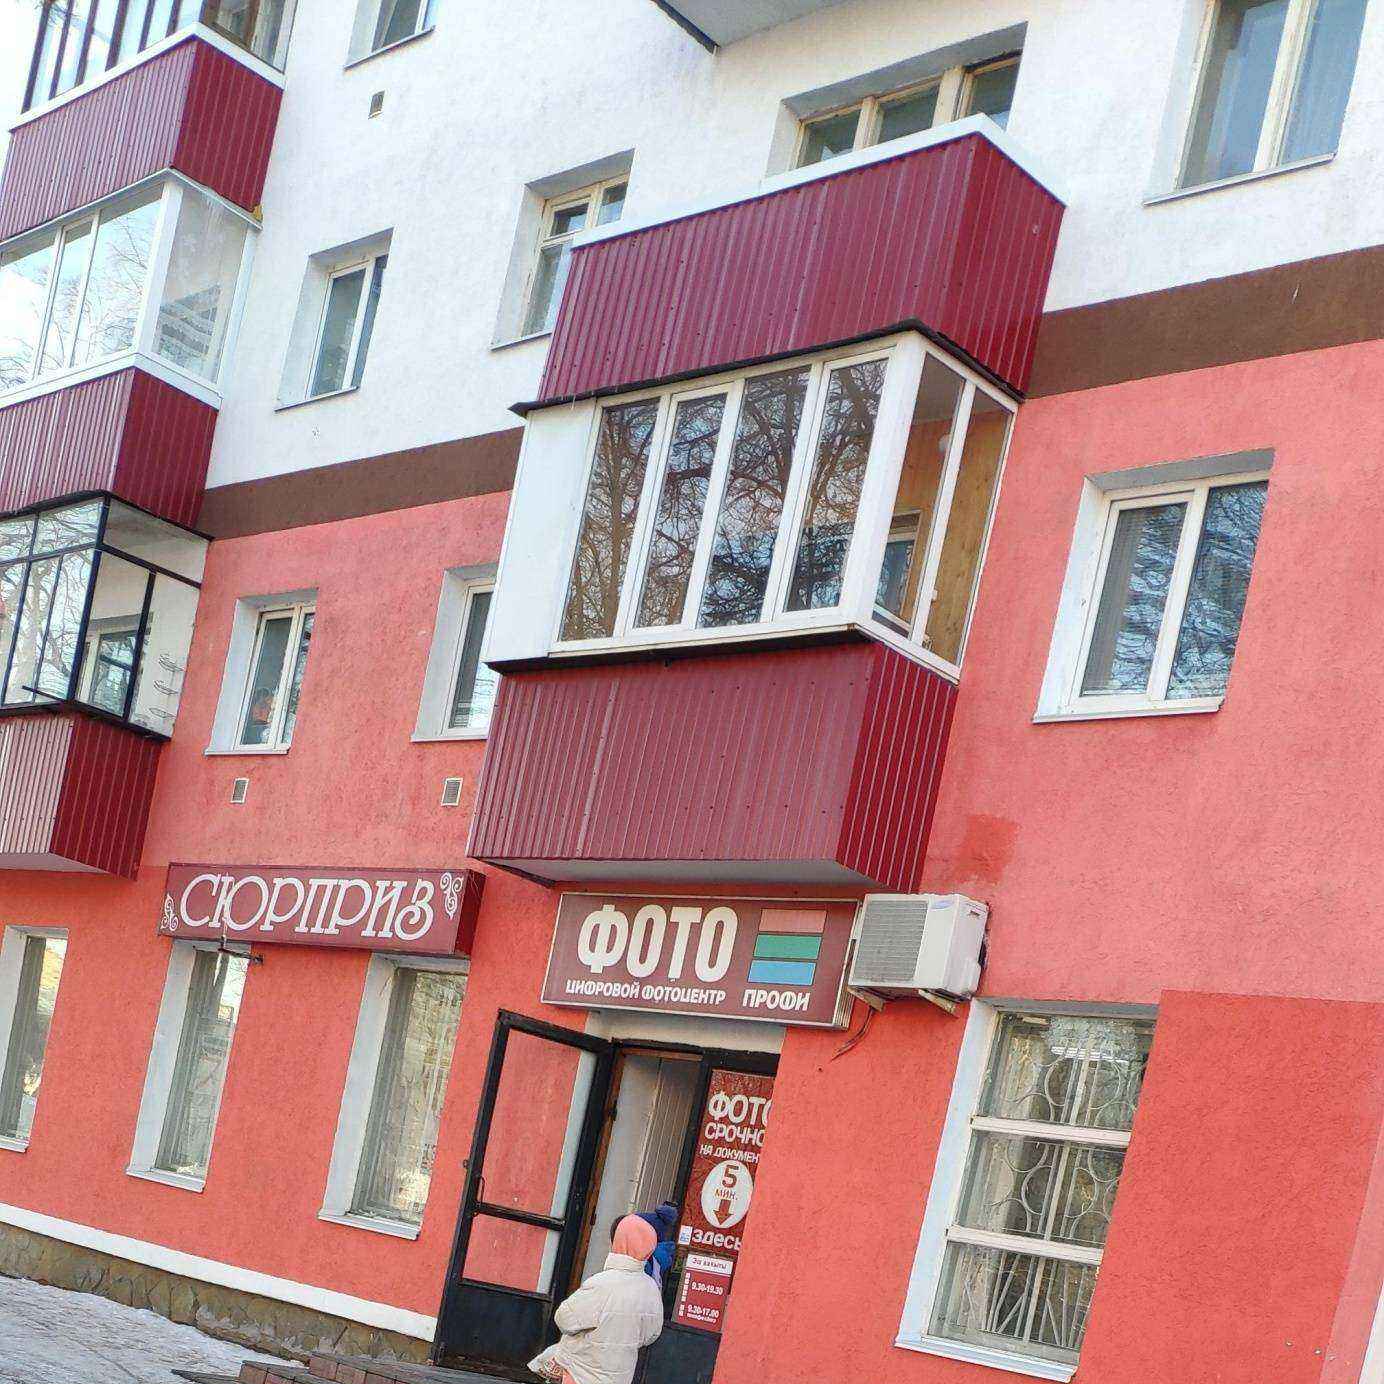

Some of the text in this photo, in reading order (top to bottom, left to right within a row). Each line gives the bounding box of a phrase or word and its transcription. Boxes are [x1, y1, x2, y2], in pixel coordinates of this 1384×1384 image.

[180, 872, 434, 941] СЮРПРИЗ
[577, 904, 739, 983] ФОТО
[565, 979, 727, 1005] ЦИФРОВОЙ ФОТОЦЕНТР
[742, 988, 811, 1012] ПРОФИ
[699, 1144, 760, 1164] НА ДОКУМЕН
[722, 1164, 740, 1188] 5
